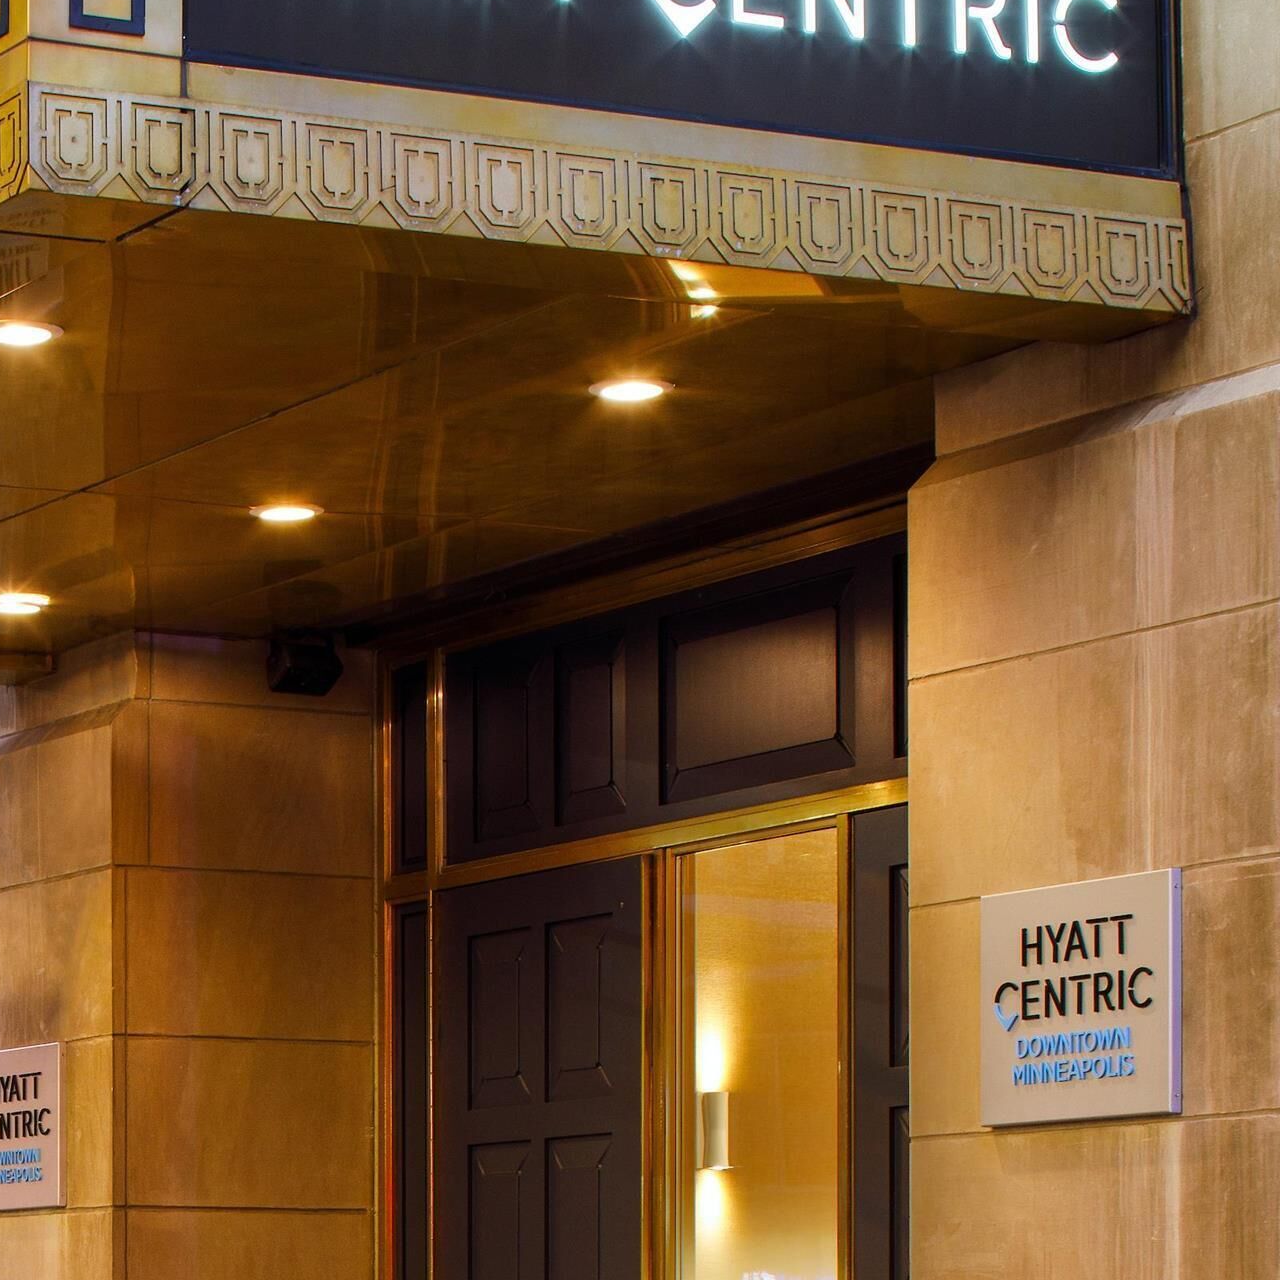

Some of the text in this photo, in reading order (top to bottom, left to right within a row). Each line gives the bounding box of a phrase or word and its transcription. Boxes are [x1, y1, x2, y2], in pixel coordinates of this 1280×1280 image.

[1021, 914, 1133, 967] HYATT
[993, 966, 1153, 1032] CENTRIC
[1015, 1026, 1131, 1060] DOWNTOWN
[1012, 1055, 1135, 1086] MINNEAPOLIS
